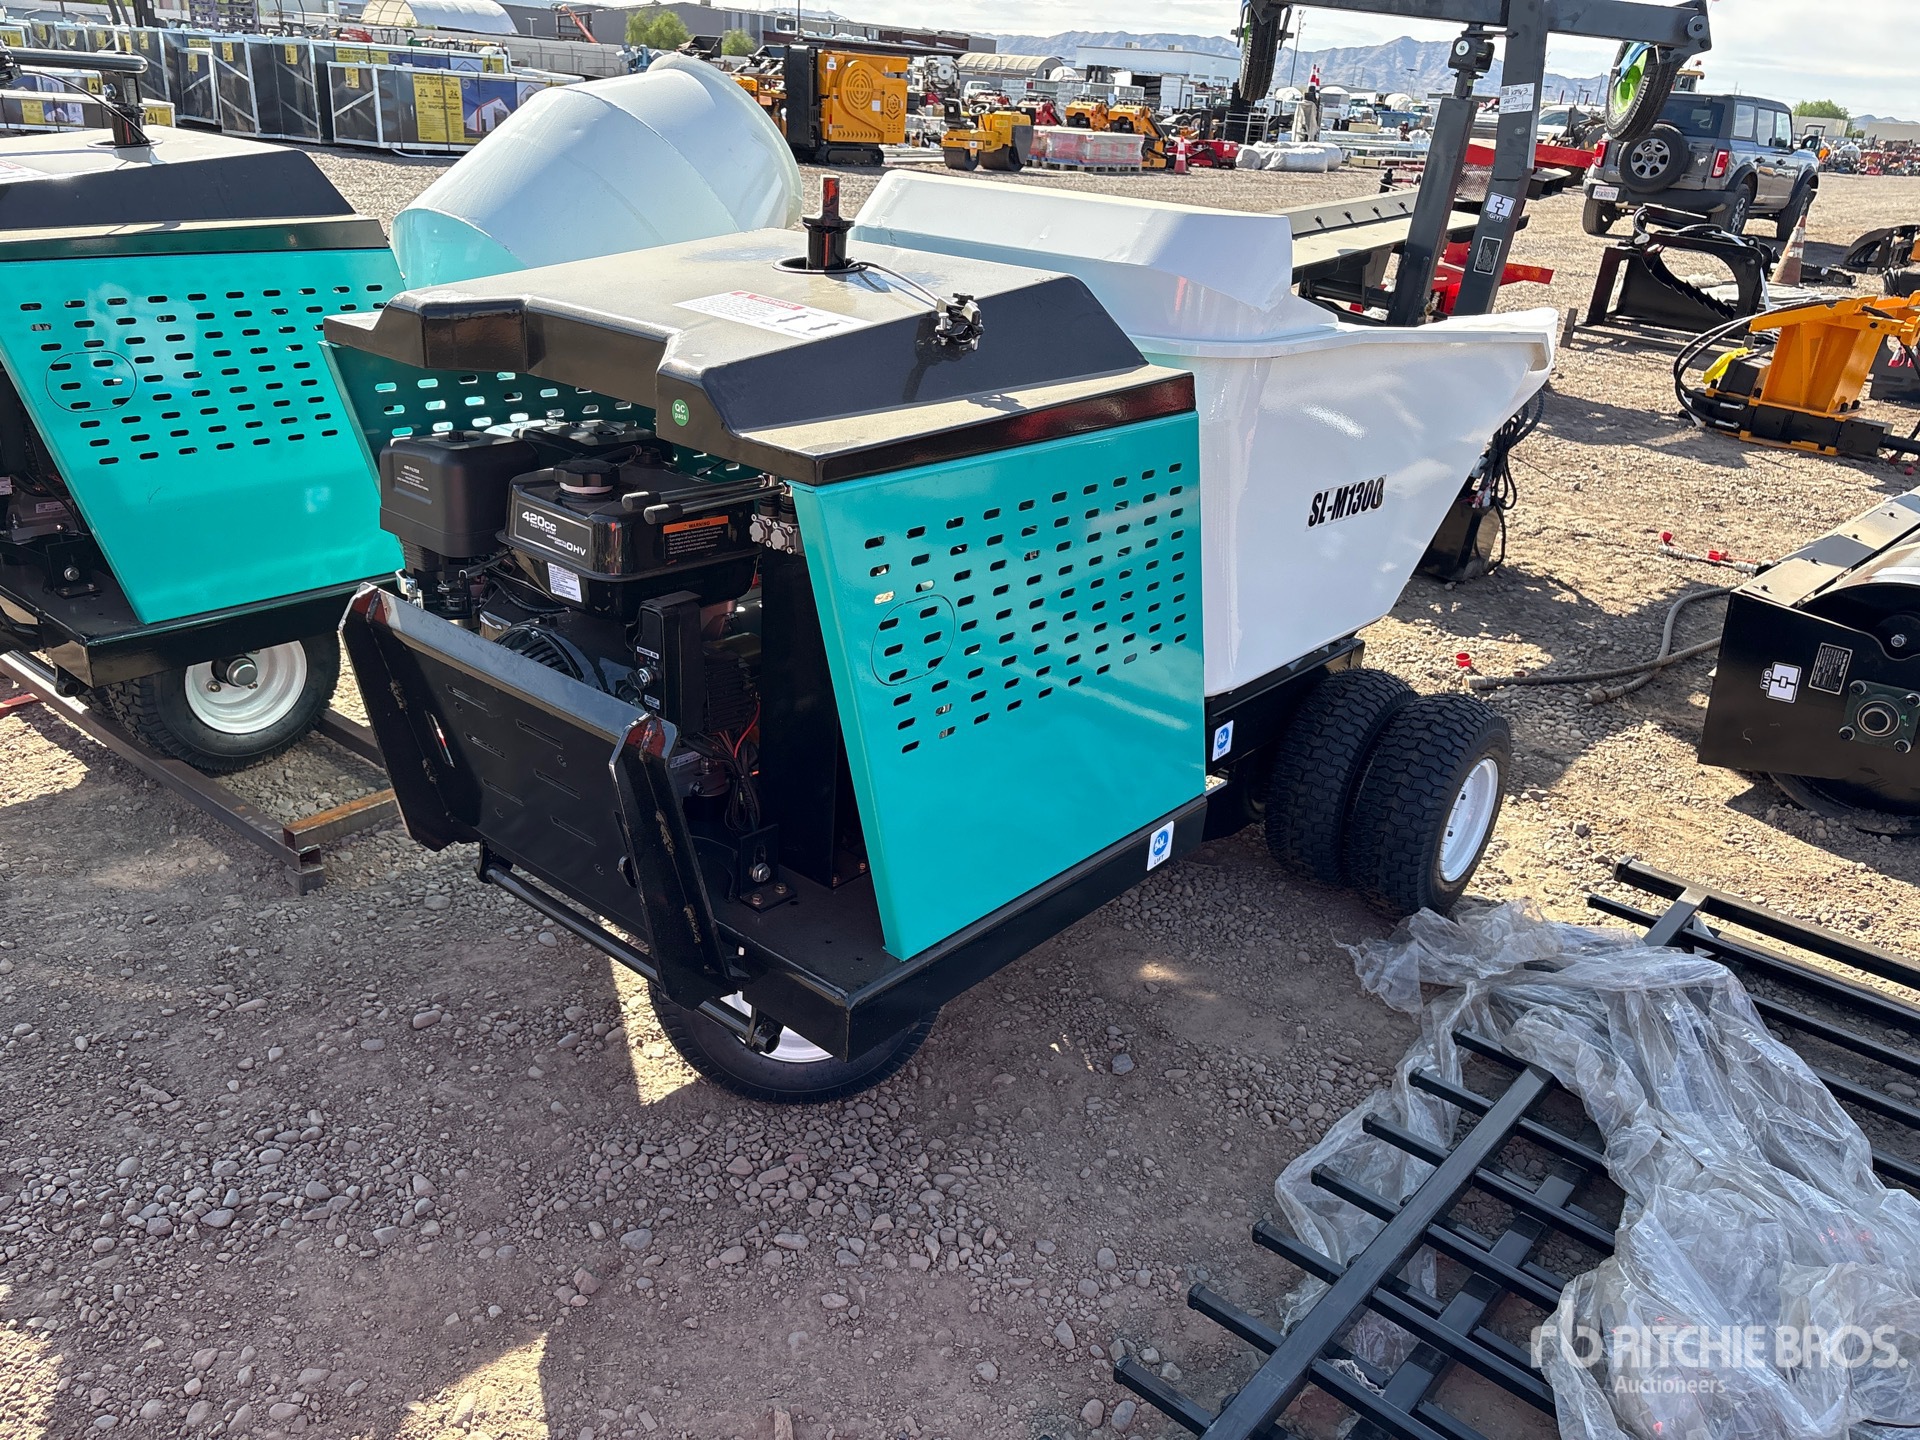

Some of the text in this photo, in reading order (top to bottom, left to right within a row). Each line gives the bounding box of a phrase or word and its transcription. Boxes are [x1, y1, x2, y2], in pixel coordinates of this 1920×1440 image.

[675, 403, 685, 413] QC
[675, 412, 686, 421] pass
[1308, 476, 1384, 527] SL-M1300
[522, 511, 557, 532] 420cc
[566, 541, 586, 556] OHV
[1761, 670, 1772, 688] GIYI
[1153, 853, 1165, 865] LIFT
